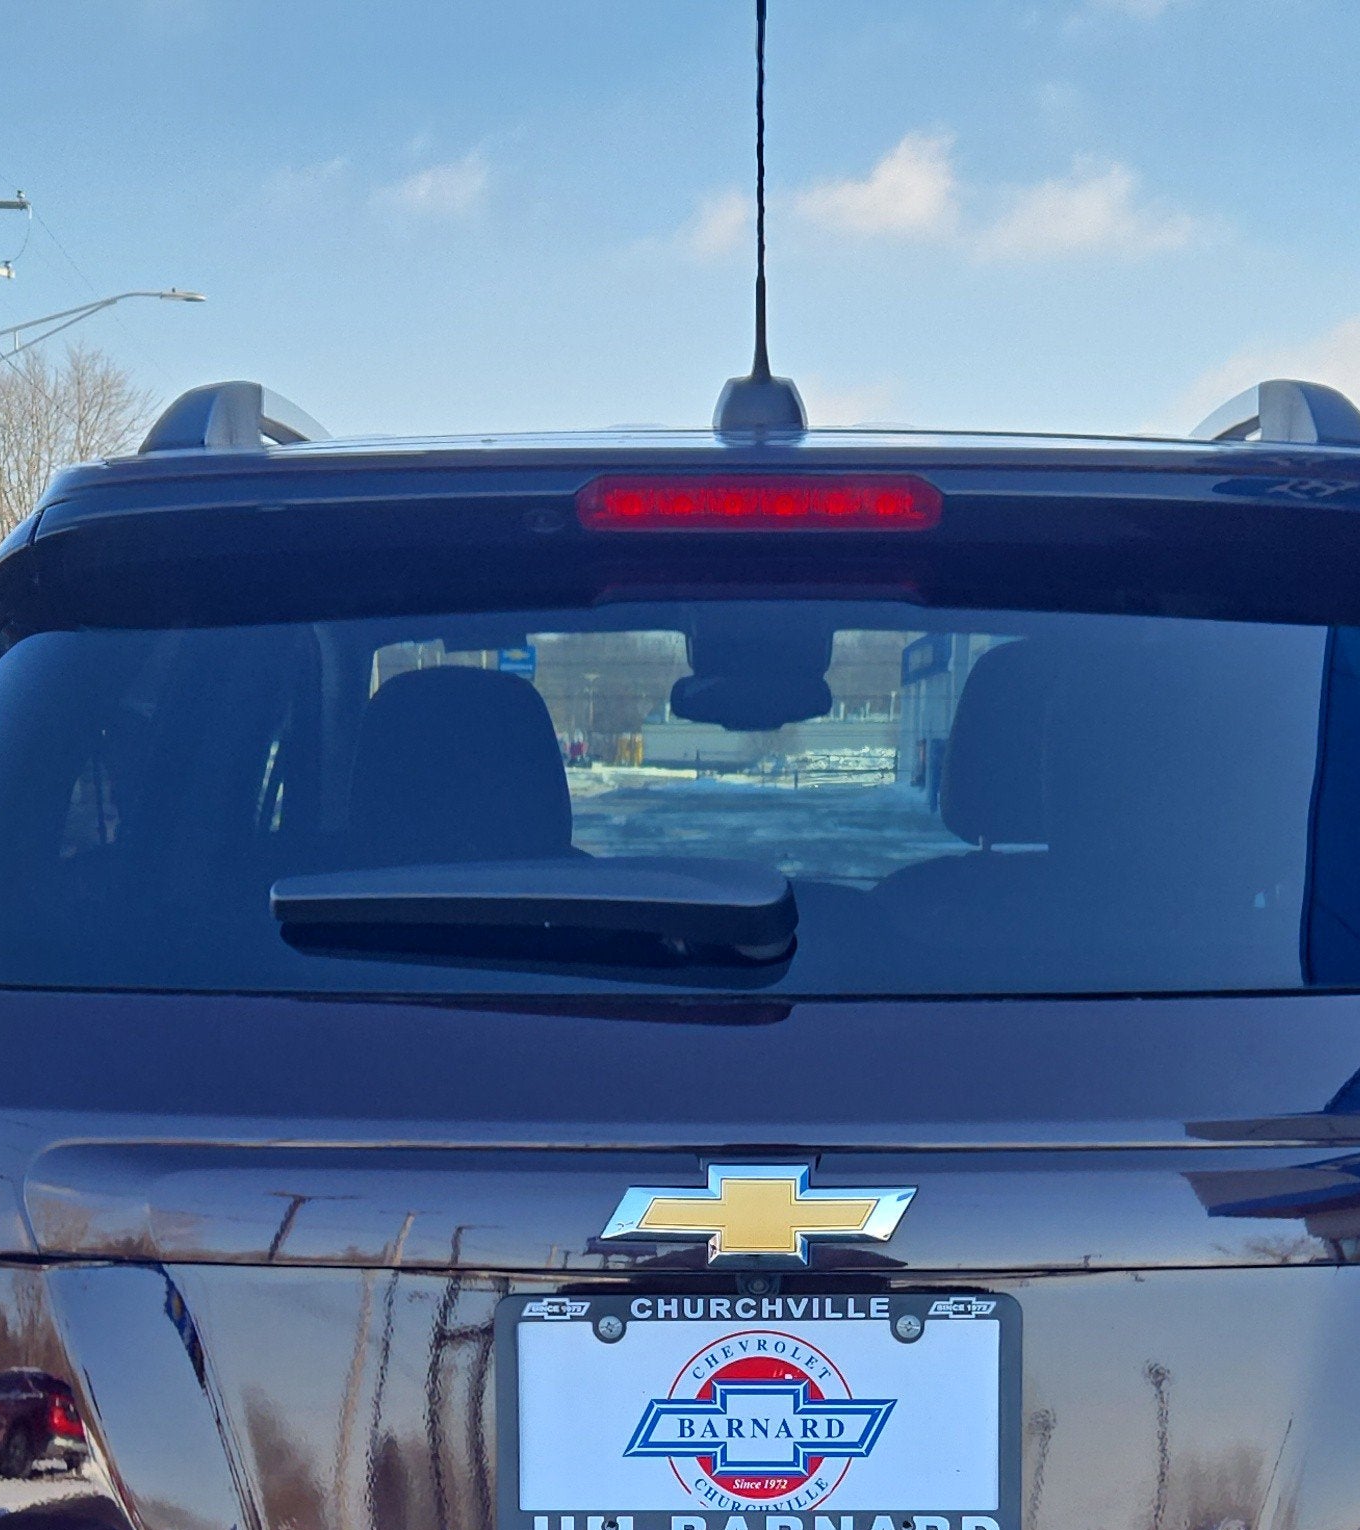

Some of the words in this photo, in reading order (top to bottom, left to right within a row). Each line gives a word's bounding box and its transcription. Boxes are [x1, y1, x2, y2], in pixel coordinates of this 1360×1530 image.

[630, 1297, 890, 1319] CHURCHVILLE
[692, 1339, 831, 1380] CHEVROLET
[677, 1418, 845, 1439] BARNARD
[733, 1478, 761, 1490] Since
[764, 1478, 788, 1490] 1972
